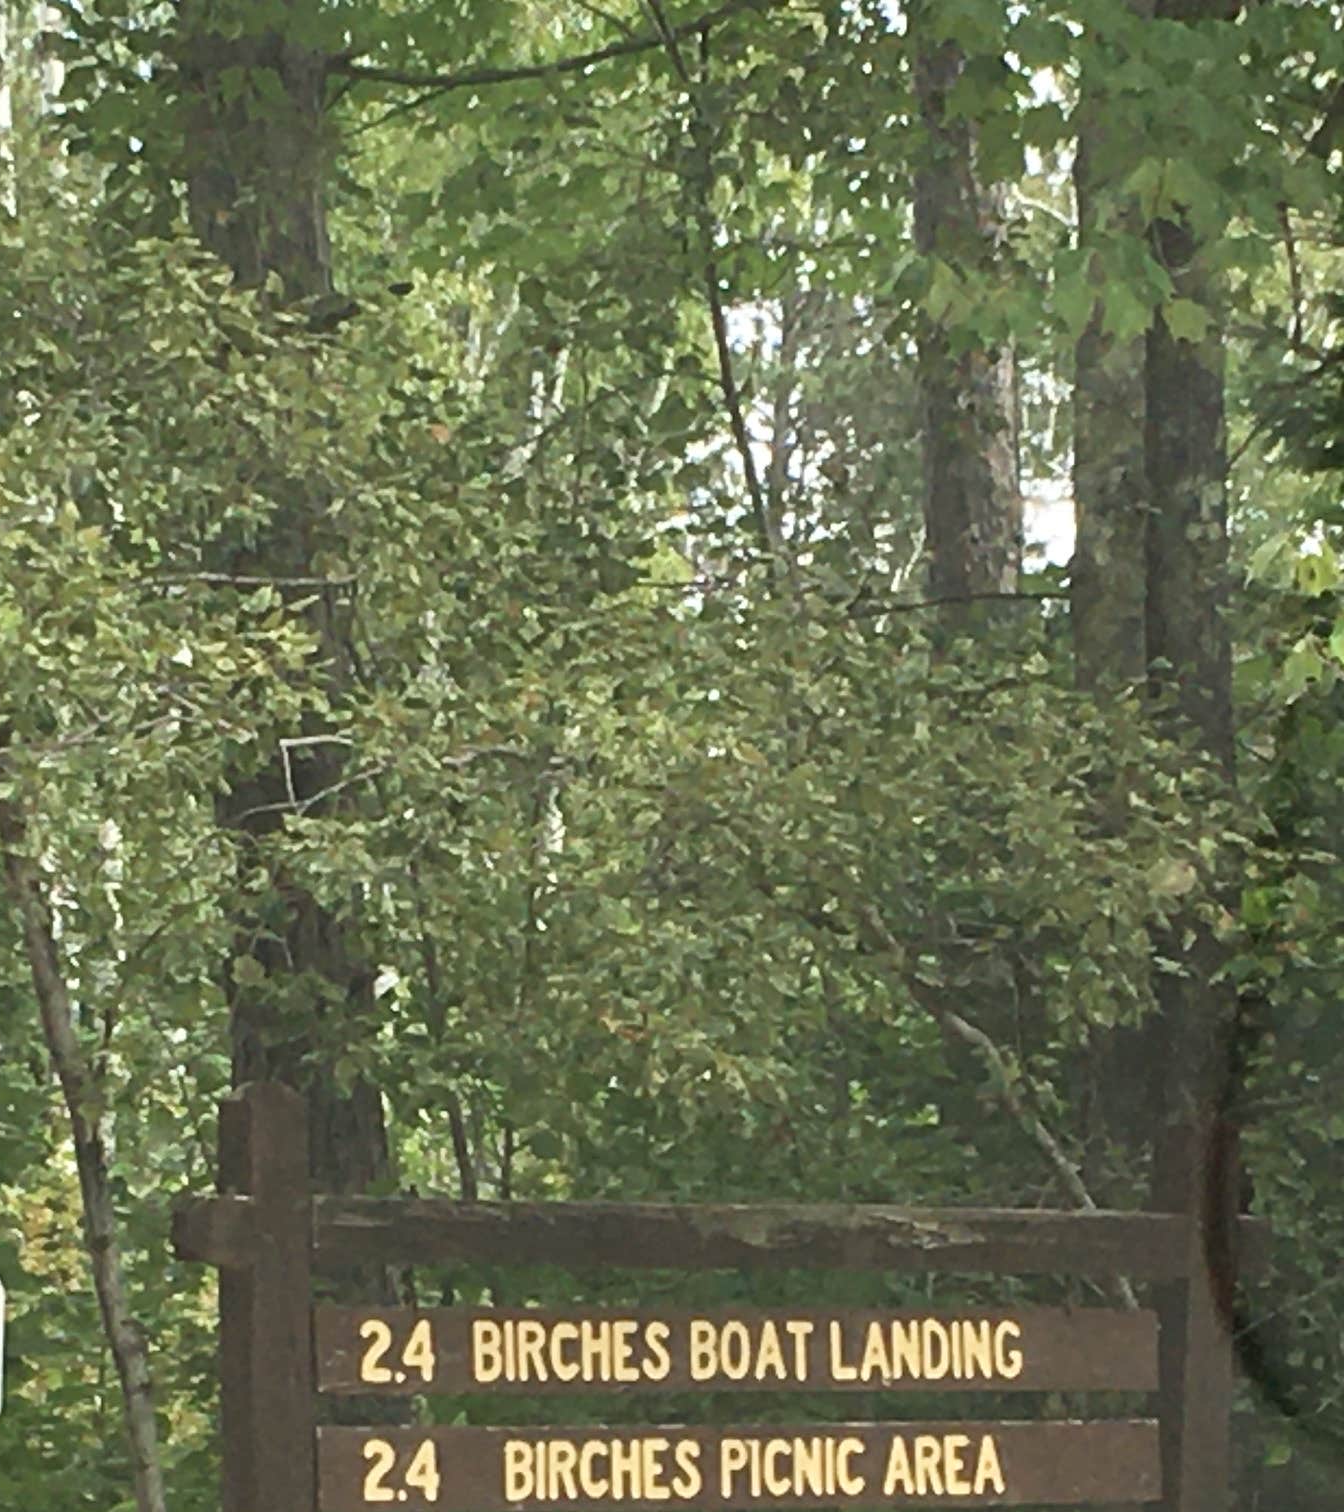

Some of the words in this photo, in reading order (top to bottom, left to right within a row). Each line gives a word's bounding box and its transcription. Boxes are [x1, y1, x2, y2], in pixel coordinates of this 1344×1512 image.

[359, 1319, 435, 1383] 2.4
[472, 1320, 671, 1383] BIRCHES
[689, 1320, 814, 1381] BOAT
[830, 1319, 1023, 1381] LANDING
[362, 1439, 440, 1501] 2.4
[504, 1438, 701, 1501] BIRCHES
[721, 1436, 866, 1498] PICNIC
[884, 1434, 1006, 1496] AREA
